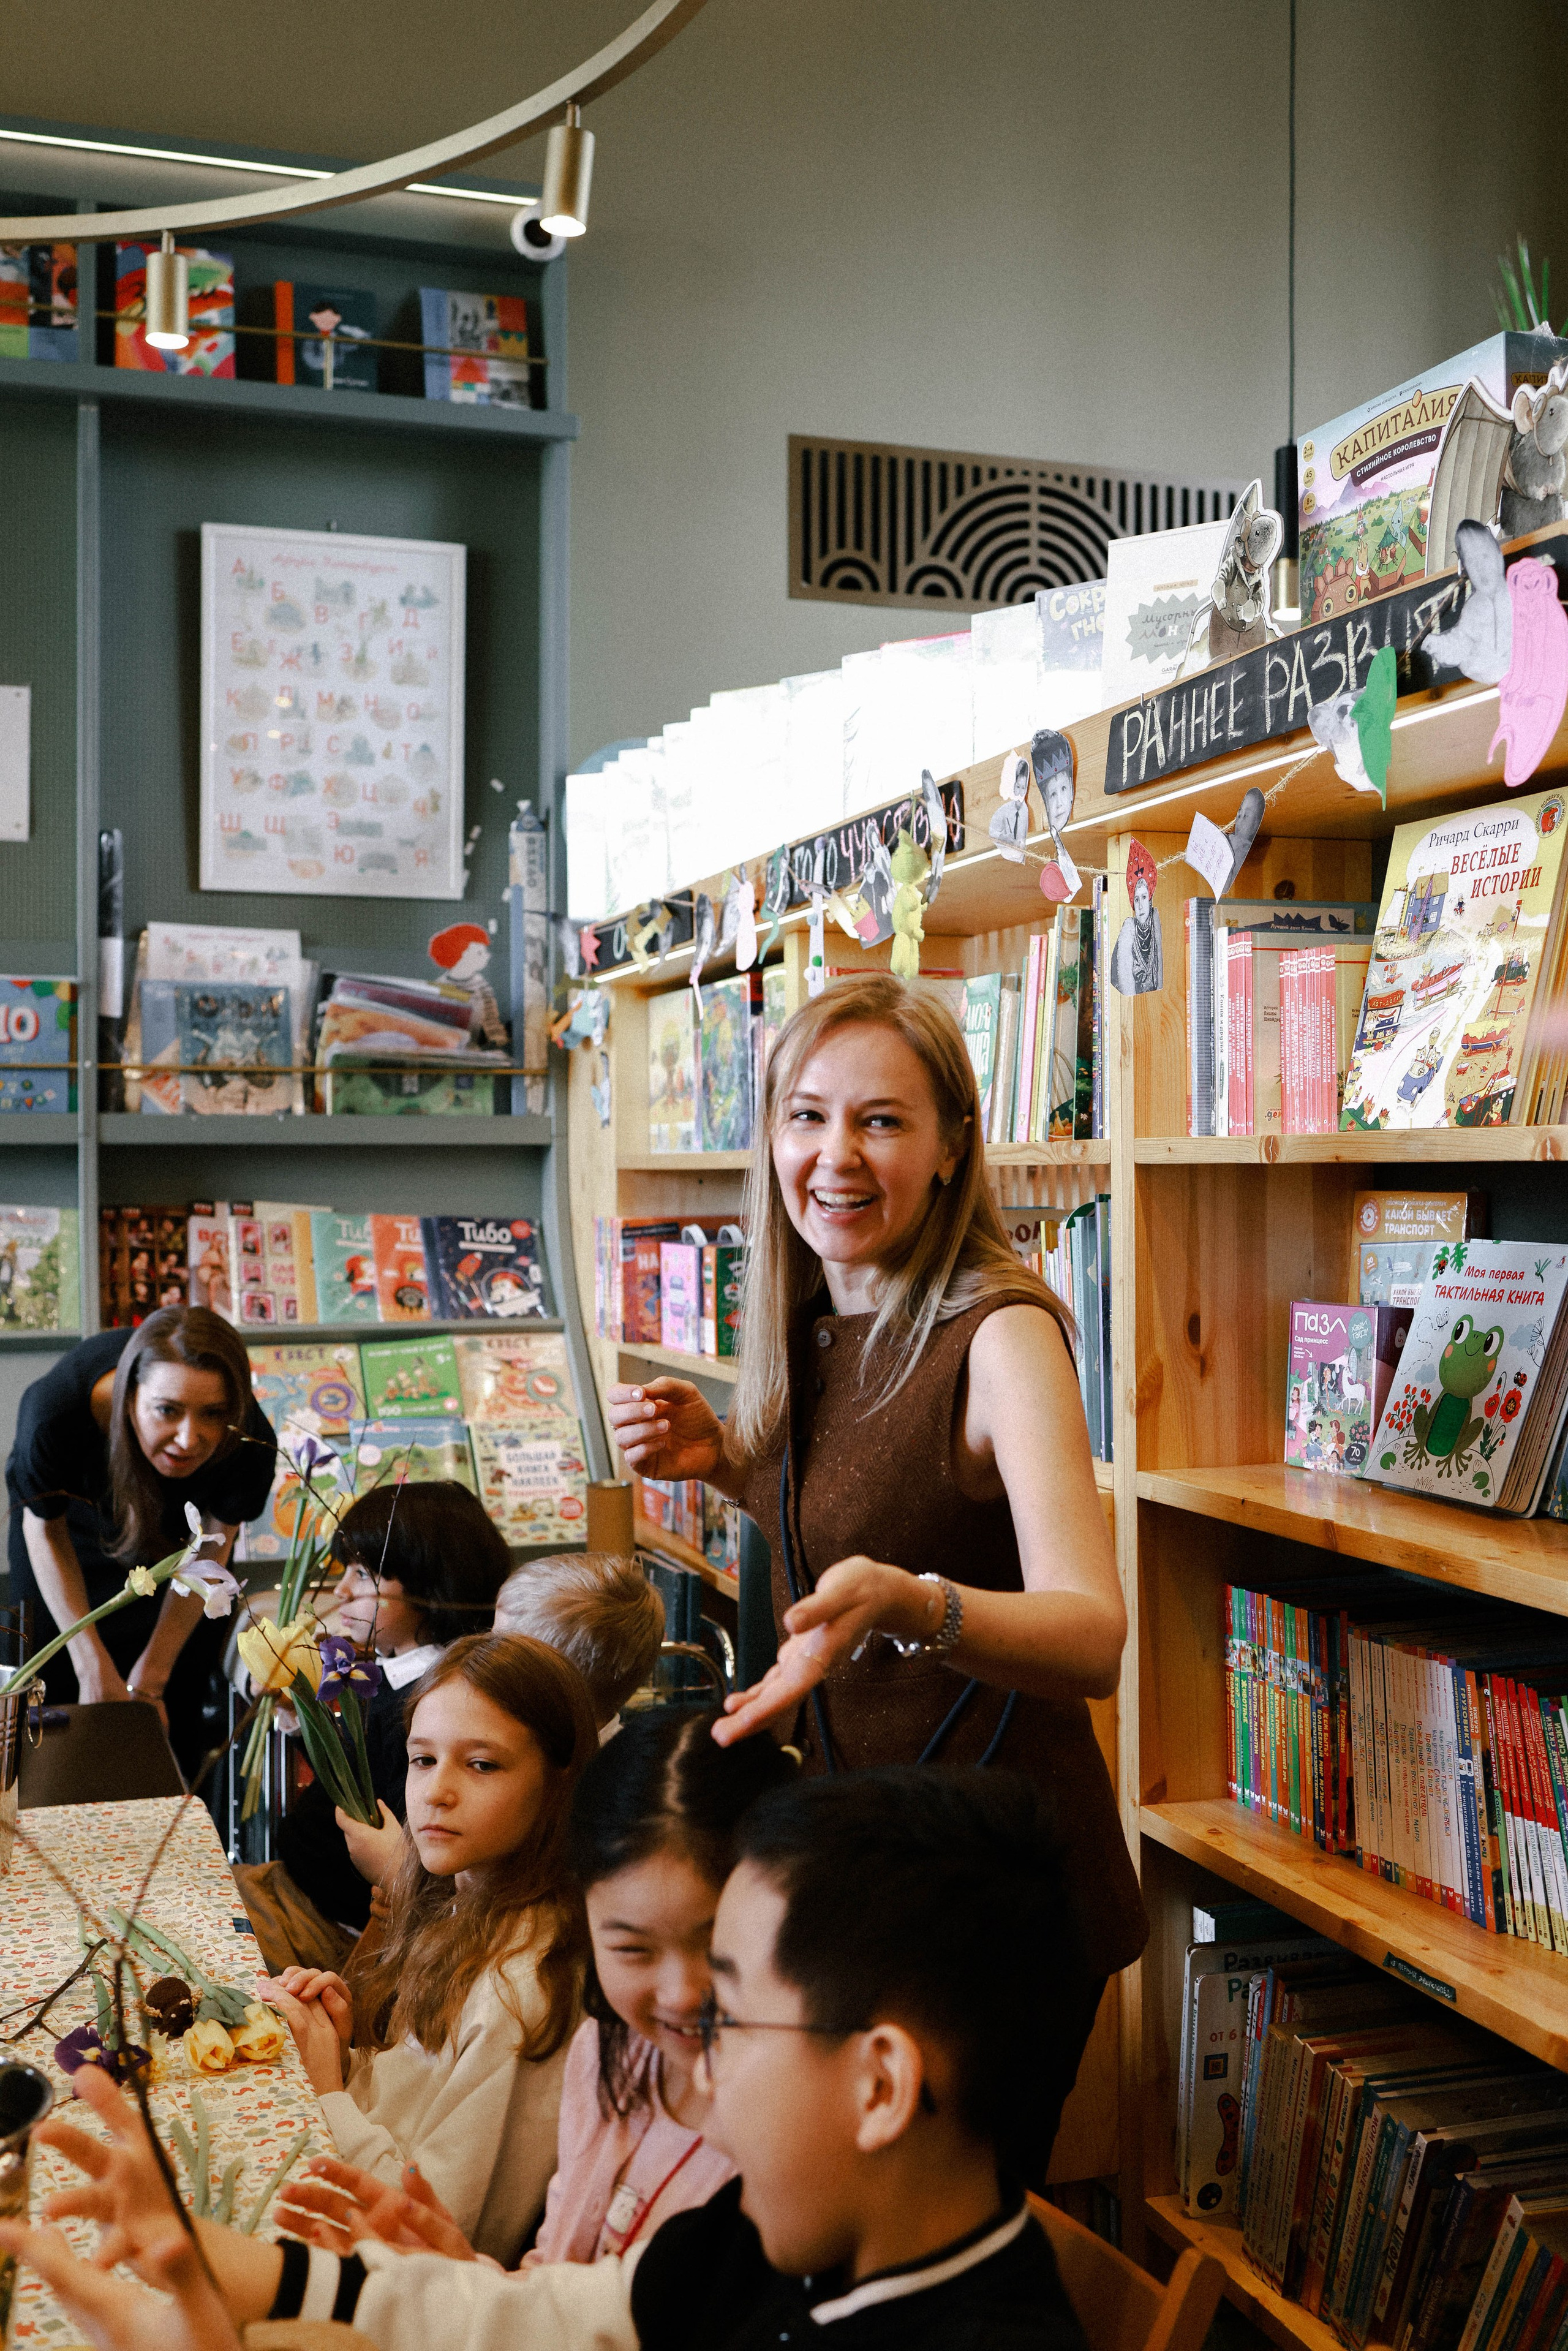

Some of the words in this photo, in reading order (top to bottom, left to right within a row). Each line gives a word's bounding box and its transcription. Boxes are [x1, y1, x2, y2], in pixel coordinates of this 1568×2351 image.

[1336, 393, 1458, 470] КАПИТАЛИЯ
[1356, 451, 1392, 477] СТИХИЙНОЕ
[1393, 434, 1436, 456] КОРОЛЕВСТВО
[1381, 467, 1404, 481] НАСТОЛЬНАЯ
[1406, 463, 1414, 472] ИГРА
[1122, 672, 1248, 786] РАННЕЕ
[1428, 829, 1469, 848] Ричард
[1474, 819, 1520, 838] Скарри
[1450, 843, 1521, 875] ВЕСЁЛЫЕ
[1471, 867, 1542, 898] ИСТОРИИ
[1385, 1209, 1414, 1220] КАКОЙ
[1385, 1223, 1435, 1236] ТРАНСПОРТ
[458, 1221, 512, 1244] Тибо
[1464, 1266, 1486, 1278] Моя
[1488, 1269, 1525, 1283] первая
[1434, 1285, 1505, 1303] ТАКТИЛЬНАЯ
[1507, 1290, 1545, 1306] КНИГА
[1351, 1446, 1360, 1457] 70
[1460, 1688, 1470, 1746] ГРУЗОВИКИ
[1494, 1695, 1502, 1740] ЭНЦИКЛОПЕДИЯ
[1512, 1702, 1521, 1748] ЭНЦИКЛОПЕДИЯ
[1546, 1716, 1556, 1747] СКАЗКИ
[1469, 1795, 1479, 1846] энциклопедия
[1528, 1824, 1540, 1876] АВТОМОБИЛИ
[1544, 1831, 1553, 1873] ТРАНСПОРТ
